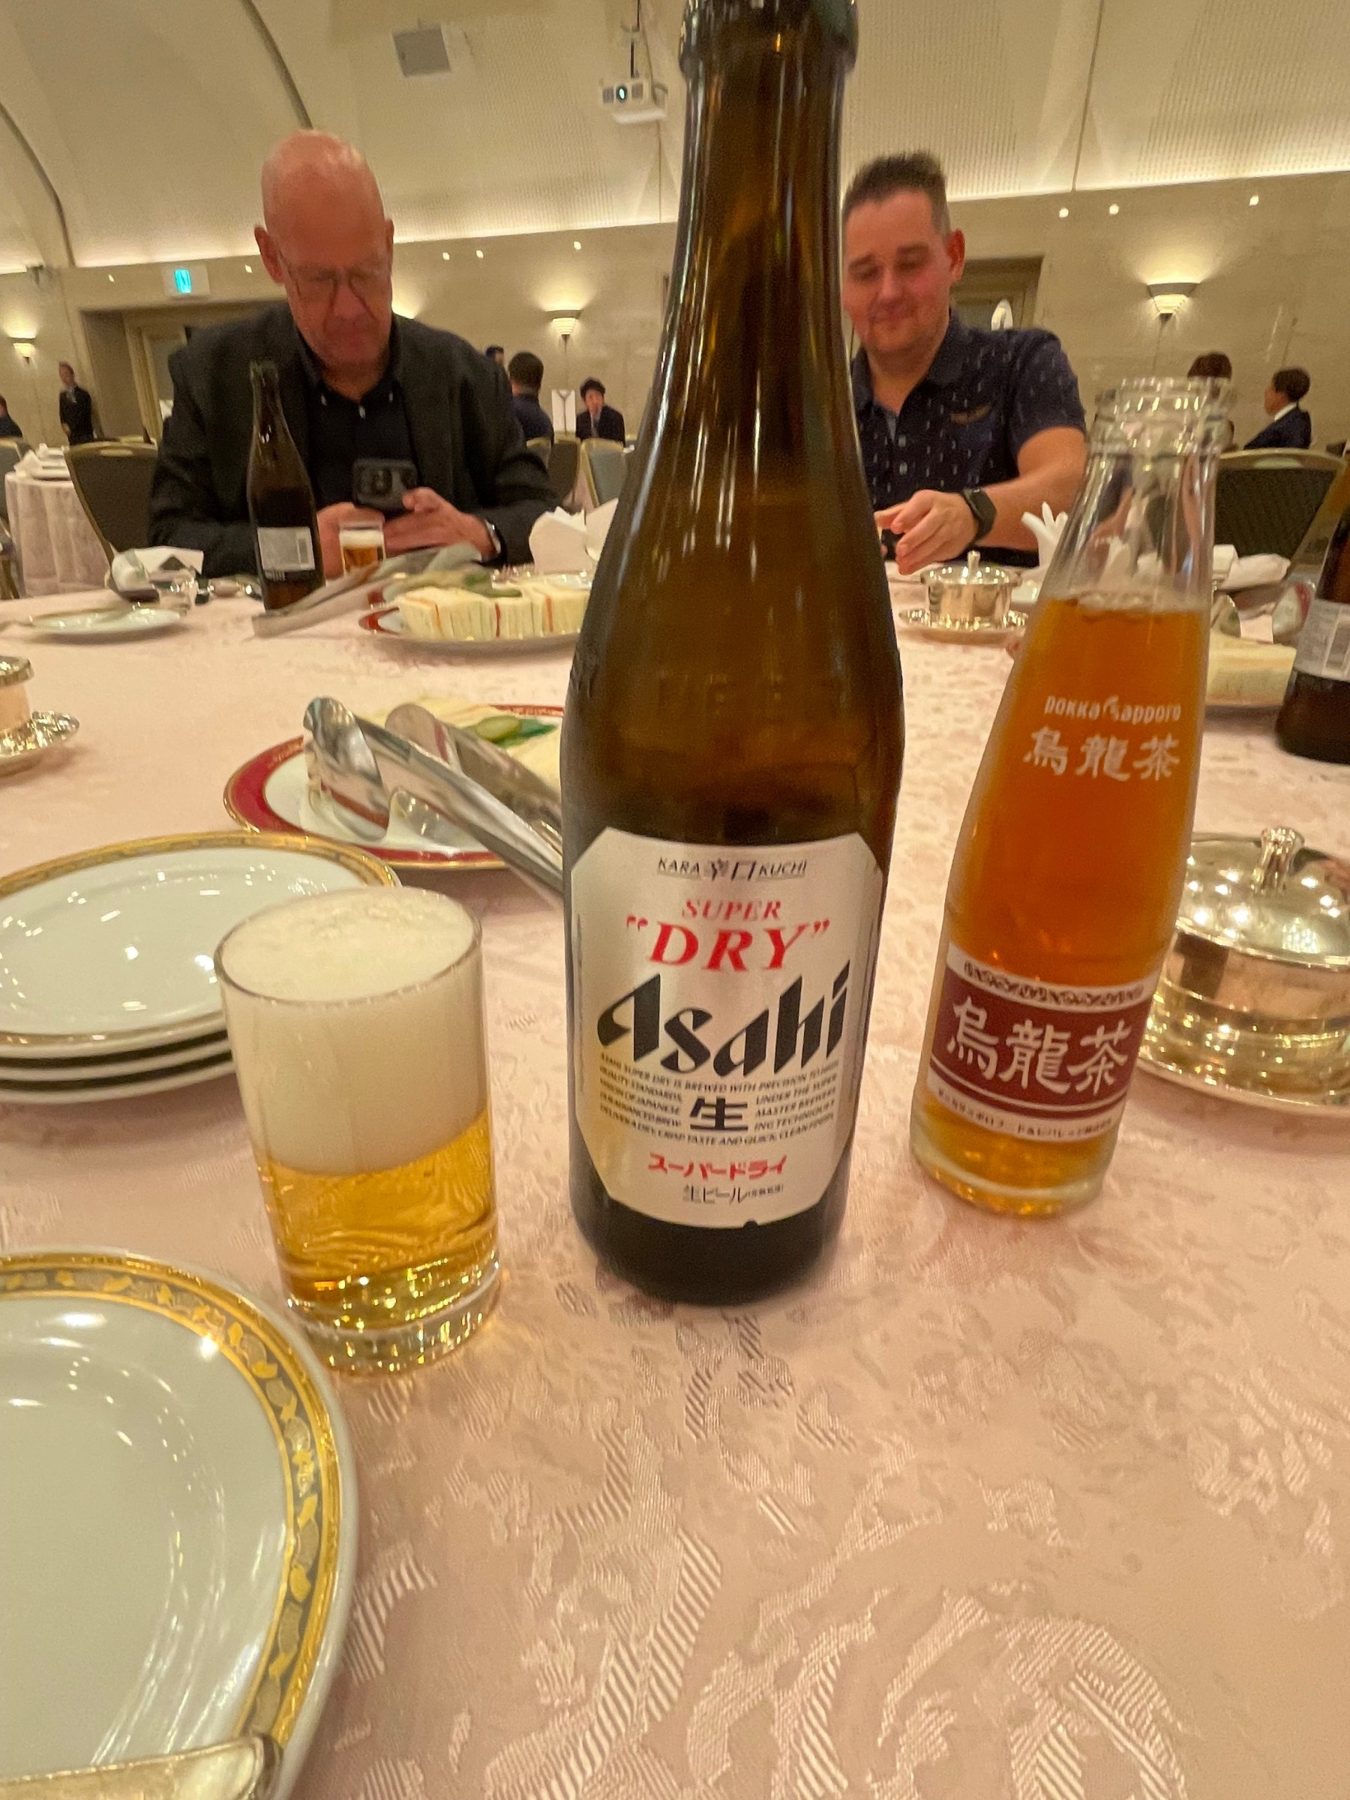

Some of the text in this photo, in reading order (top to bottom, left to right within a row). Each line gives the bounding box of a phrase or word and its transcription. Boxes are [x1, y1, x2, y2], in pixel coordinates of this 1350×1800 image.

[1023, 726, 1181, 782] 烏龍茶
[658, 857, 700, 876] KARA
[758, 859, 807, 876] KUCHI
[682, 899, 781, 922] SUPER
[597, 959, 850, 1078] Asahi
[948, 995, 1132, 1096] 烏龍茶
[685, 1081, 727, 1093] BREWED
[730, 1083, 756, 1093] WITH
[756, 1090, 791, 1105] UNDER
[689, 1096, 748, 1130] 生
[755, 1102, 796, 1118] MASTER
[687, 1134, 715, 1146] TASTE
[718, 1136, 743, 1147] AND
[648, 1152, 787, 1181] スーパードライ
